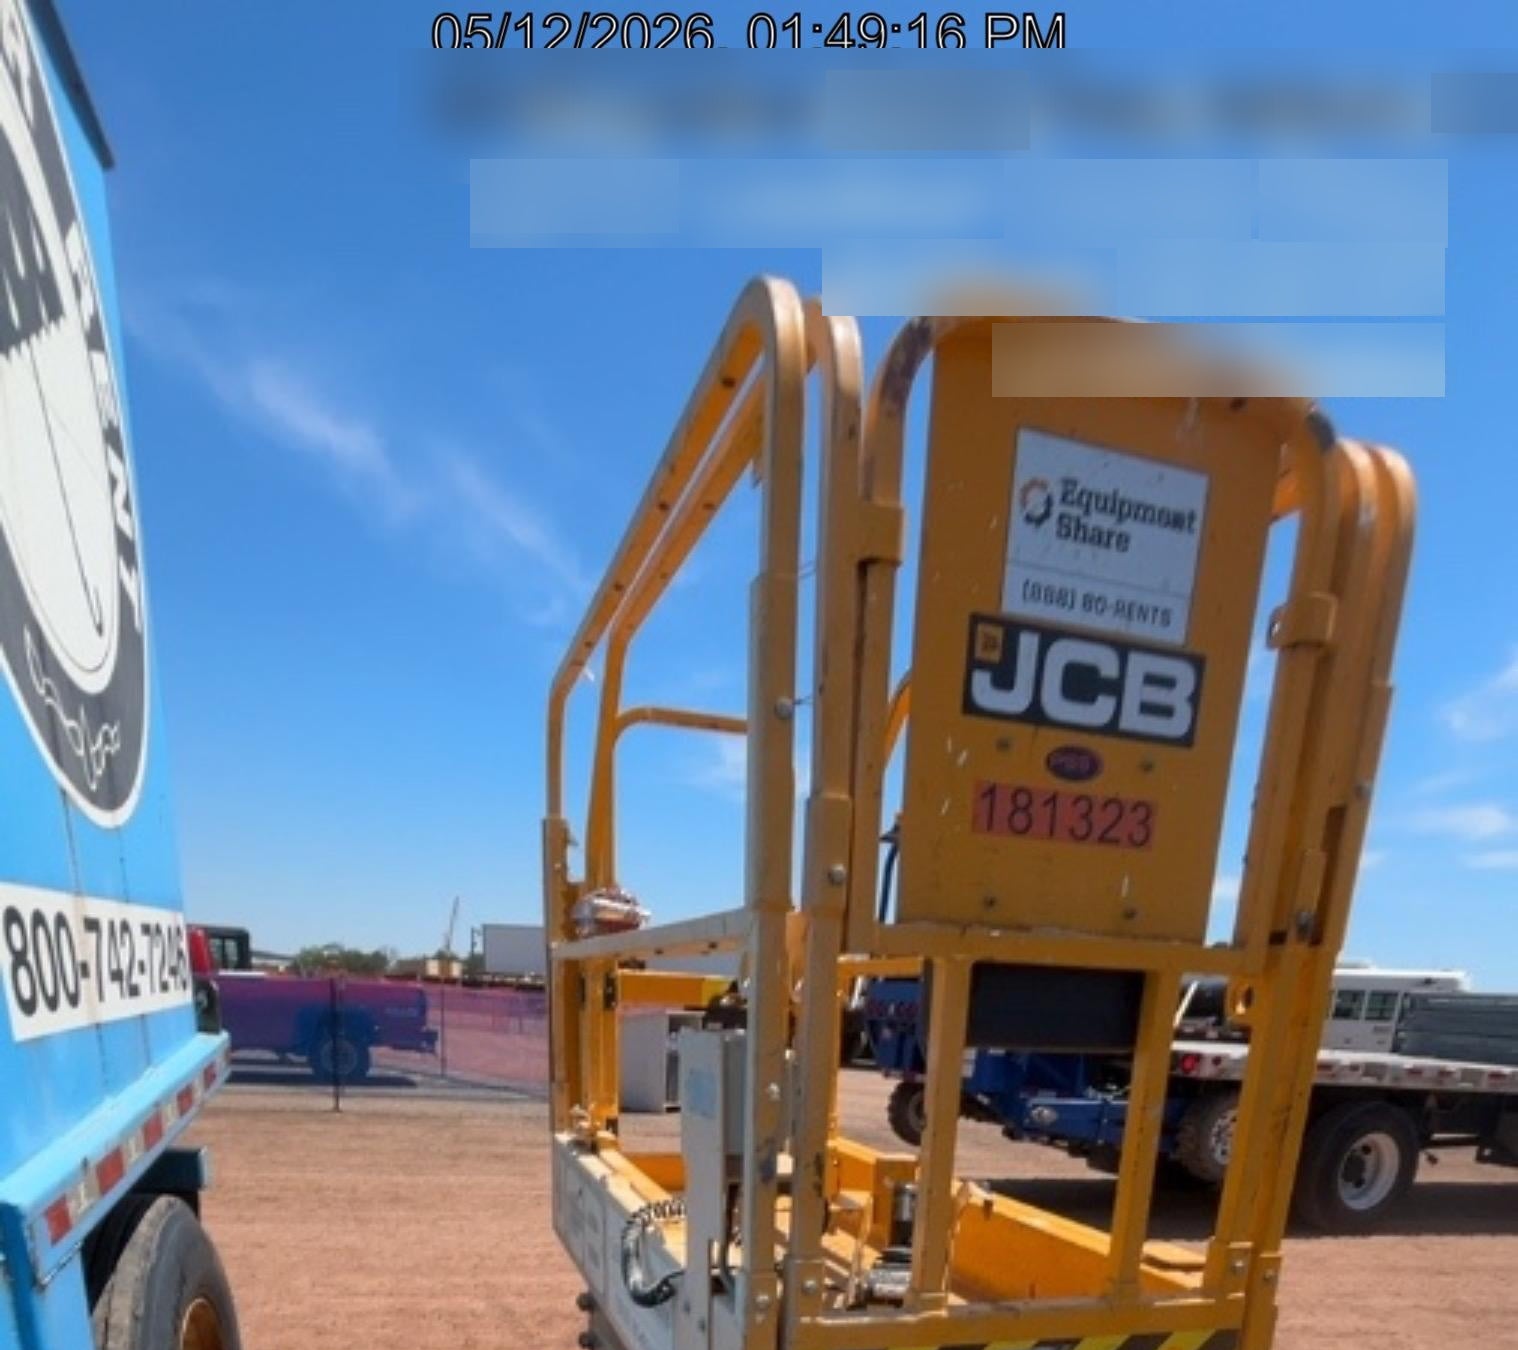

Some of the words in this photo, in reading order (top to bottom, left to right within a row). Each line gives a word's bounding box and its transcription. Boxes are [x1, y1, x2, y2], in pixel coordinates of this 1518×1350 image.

[1056, 511, 1131, 553] Share
[971, 630, 1196, 738] JCB
[980, 782, 1152, 848] 181323
[4, 905, 188, 1018] 800-742-7246
